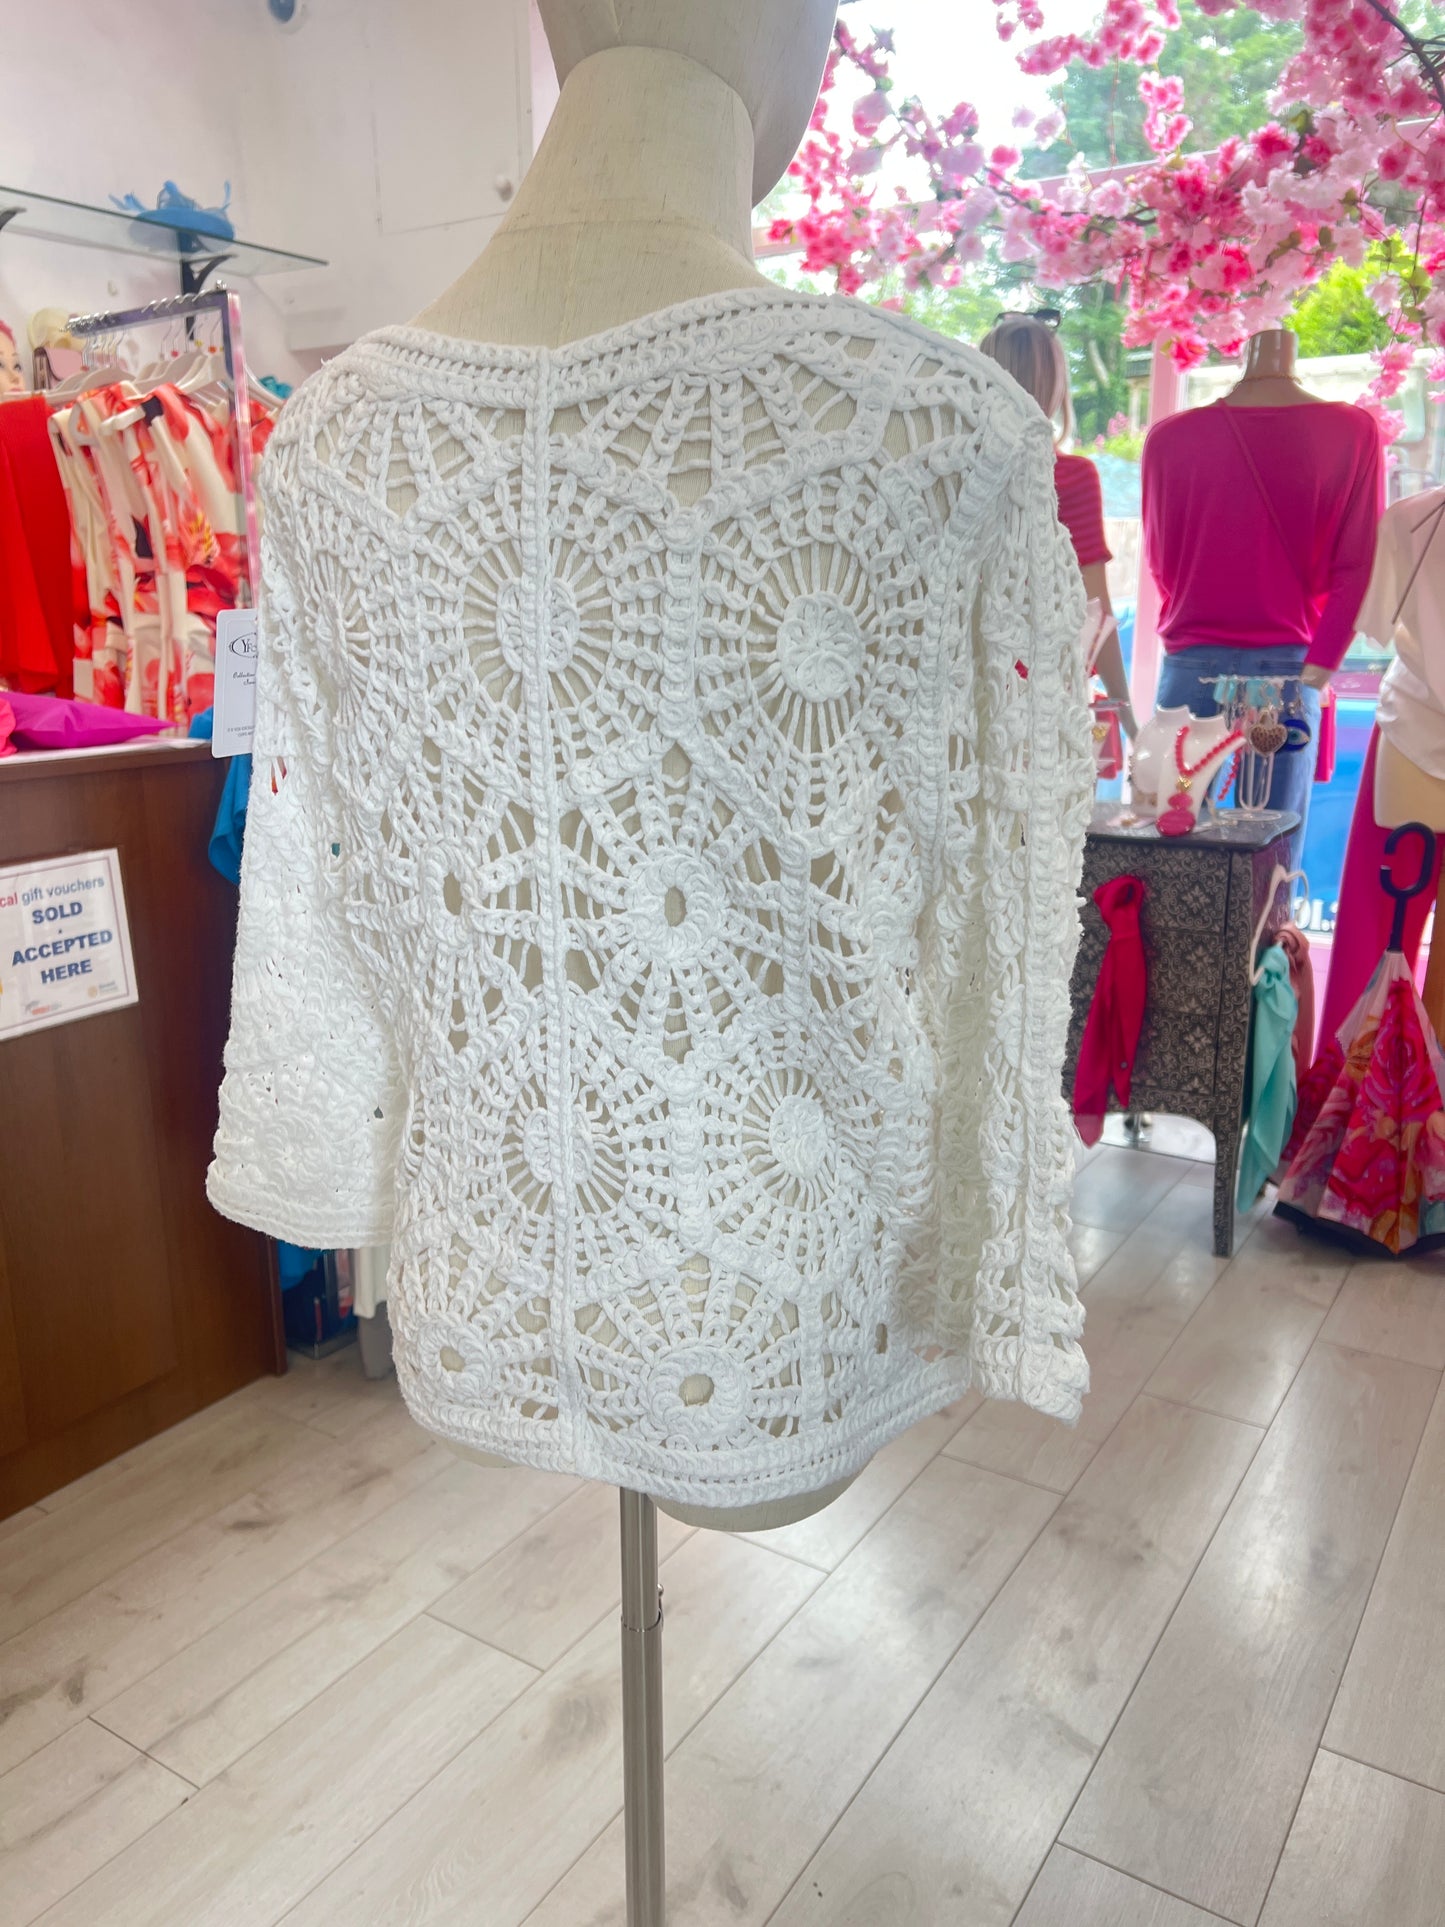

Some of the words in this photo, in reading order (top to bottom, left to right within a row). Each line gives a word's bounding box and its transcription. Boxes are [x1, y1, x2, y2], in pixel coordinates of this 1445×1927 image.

[22, 887, 43, 906] gift
[47, 877, 105, 898] vouchers
[32, 901, 83, 924] SOLD
[12, 930, 113, 966] ACCEPTED
[41, 959, 92, 984] HERE
